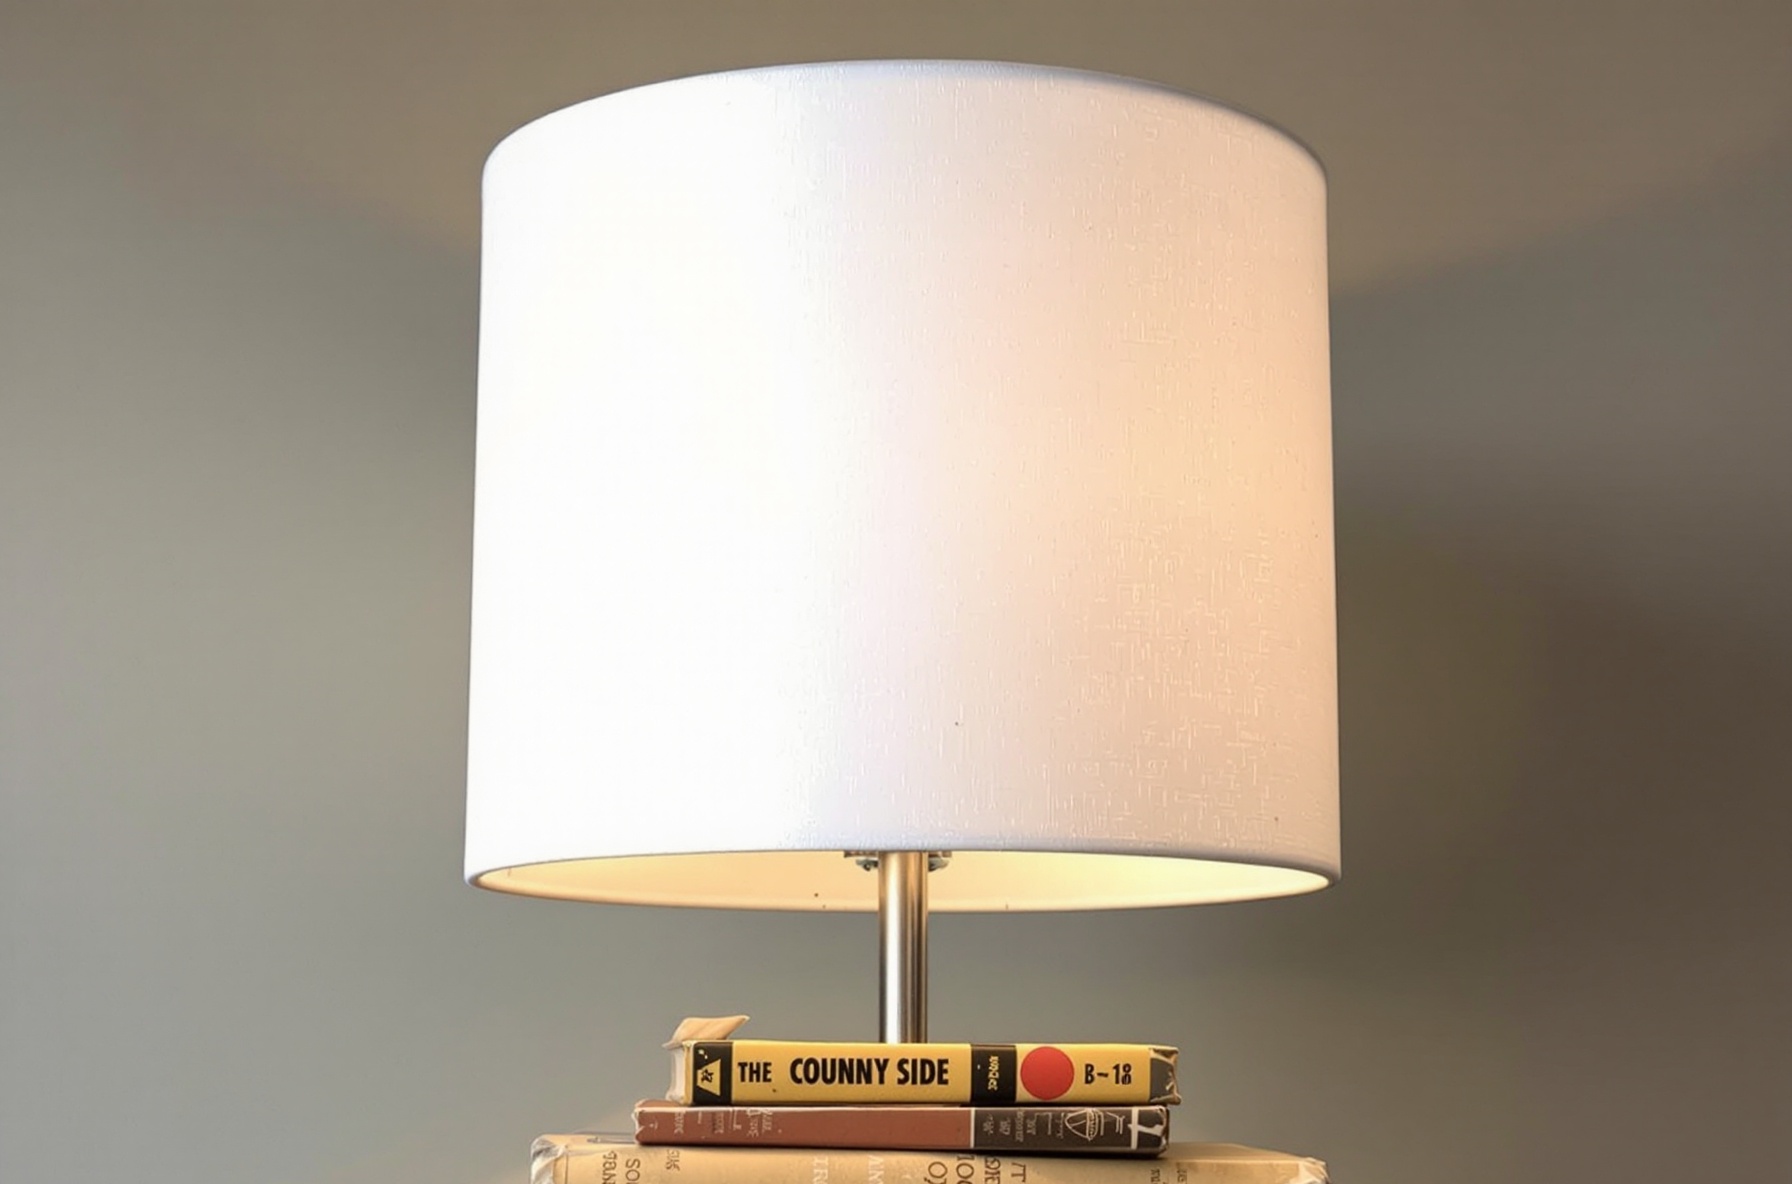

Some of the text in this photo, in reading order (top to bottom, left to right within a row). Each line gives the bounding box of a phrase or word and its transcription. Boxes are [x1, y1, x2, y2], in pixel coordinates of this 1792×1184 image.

[738, 1057, 949, 1085] THE COUNNY SIDE
